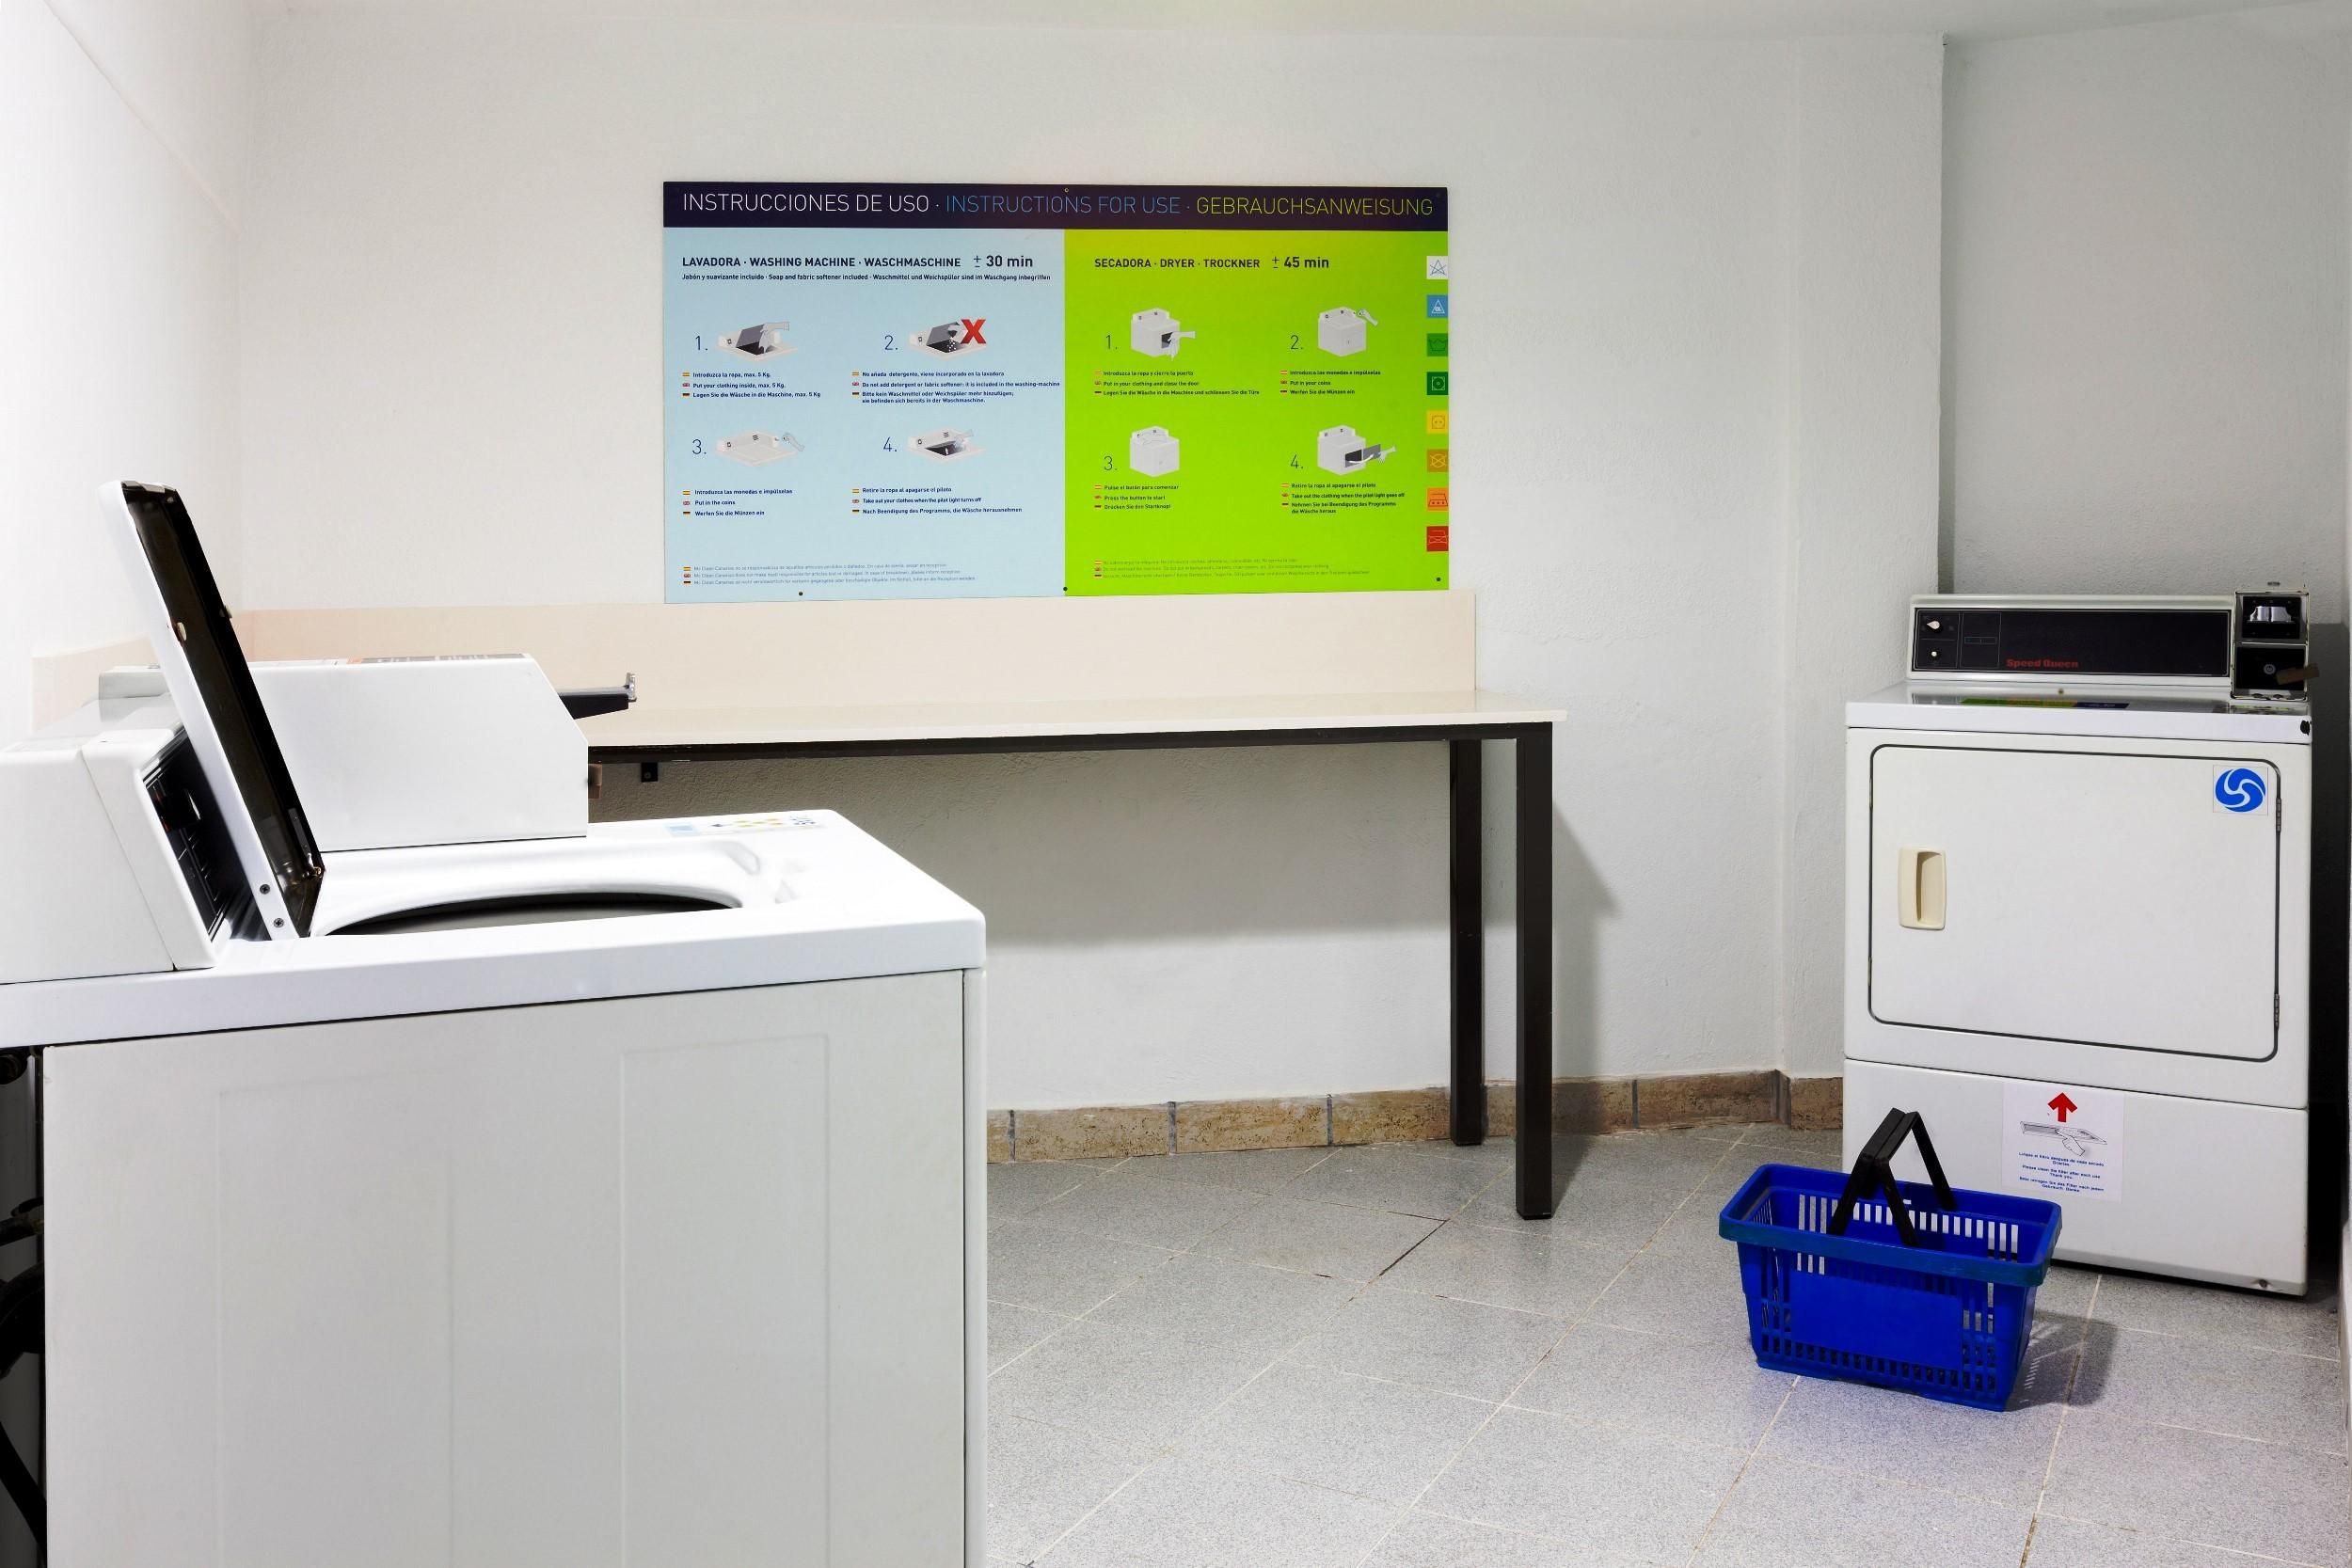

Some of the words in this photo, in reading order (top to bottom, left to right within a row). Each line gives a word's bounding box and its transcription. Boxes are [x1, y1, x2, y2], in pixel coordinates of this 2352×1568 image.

[684, 193, 849, 211] INSTRUCCIONES
[856, 194, 881, 211] DE
[889, 195, 929, 212] USO
[947, 195, 1091, 213] INSTRUCTIONS
[1098, 196, 1135, 213] FOR
[1142, 197, 1181, 213] USE
[1197, 197, 1432, 215] GEBRAUCHSANWEISUNG
[682, 257, 740, 267] LAVADORA
[750, 257, 802, 266] WASHING
[805, 257, 855, 267] MACHINE
[865, 257, 960, 267] WASCHMASCHINE
[986, 255, 1002, 267] 30
[1007, 255, 1033, 267] min
[1095, 258, 1151, 268] SECADORA
[1160, 259, 1194, 267] DRYER
[1205, 259, 1260, 268] TROCKNER
[1284, 256, 1300, 268] 45
[1304, 257, 1329, 268] min
[695, 335, 709, 351] 1.
[885, 335, 899, 351] 2.
[1106, 335, 1118, 350] 1.
[1290, 335, 1304, 350] 2.
[692, 439, 707, 455] 3.
[883, 438, 898, 453] 4.
[1104, 455, 1118, 471] 3.
[1290, 454, 1304, 469] 4.
[2008, 659, 2041, 669] Speed
[2043, 659, 2078, 668] Queen
